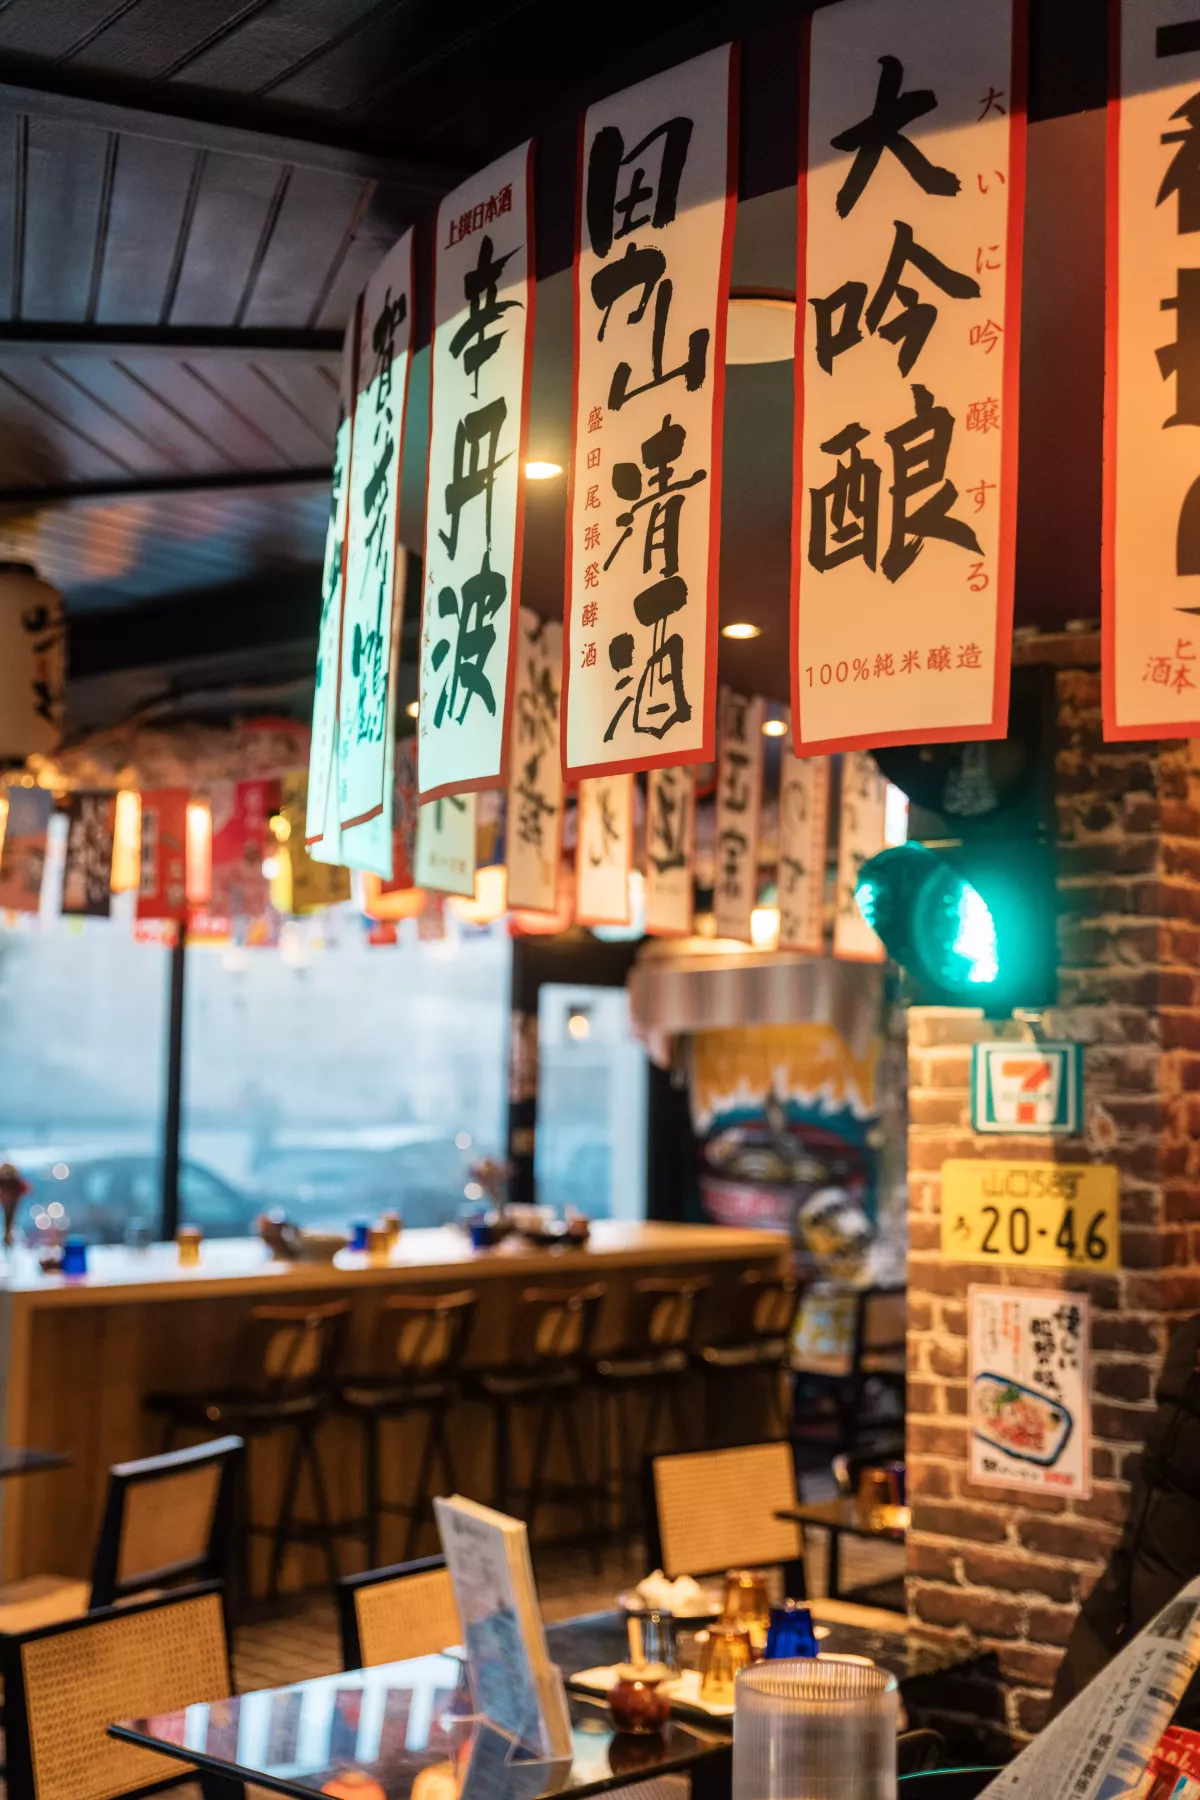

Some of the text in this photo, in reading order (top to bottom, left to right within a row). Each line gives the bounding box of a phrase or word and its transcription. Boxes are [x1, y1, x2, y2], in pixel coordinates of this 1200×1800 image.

[965, 87, 1008, 593] 大いに吟醸する
[580, 405, 604, 669] 盛田尾張発酵酒
[805, 643, 983, 688] 100%純米醸造
[1001, 1060, 1051, 1124] 7
